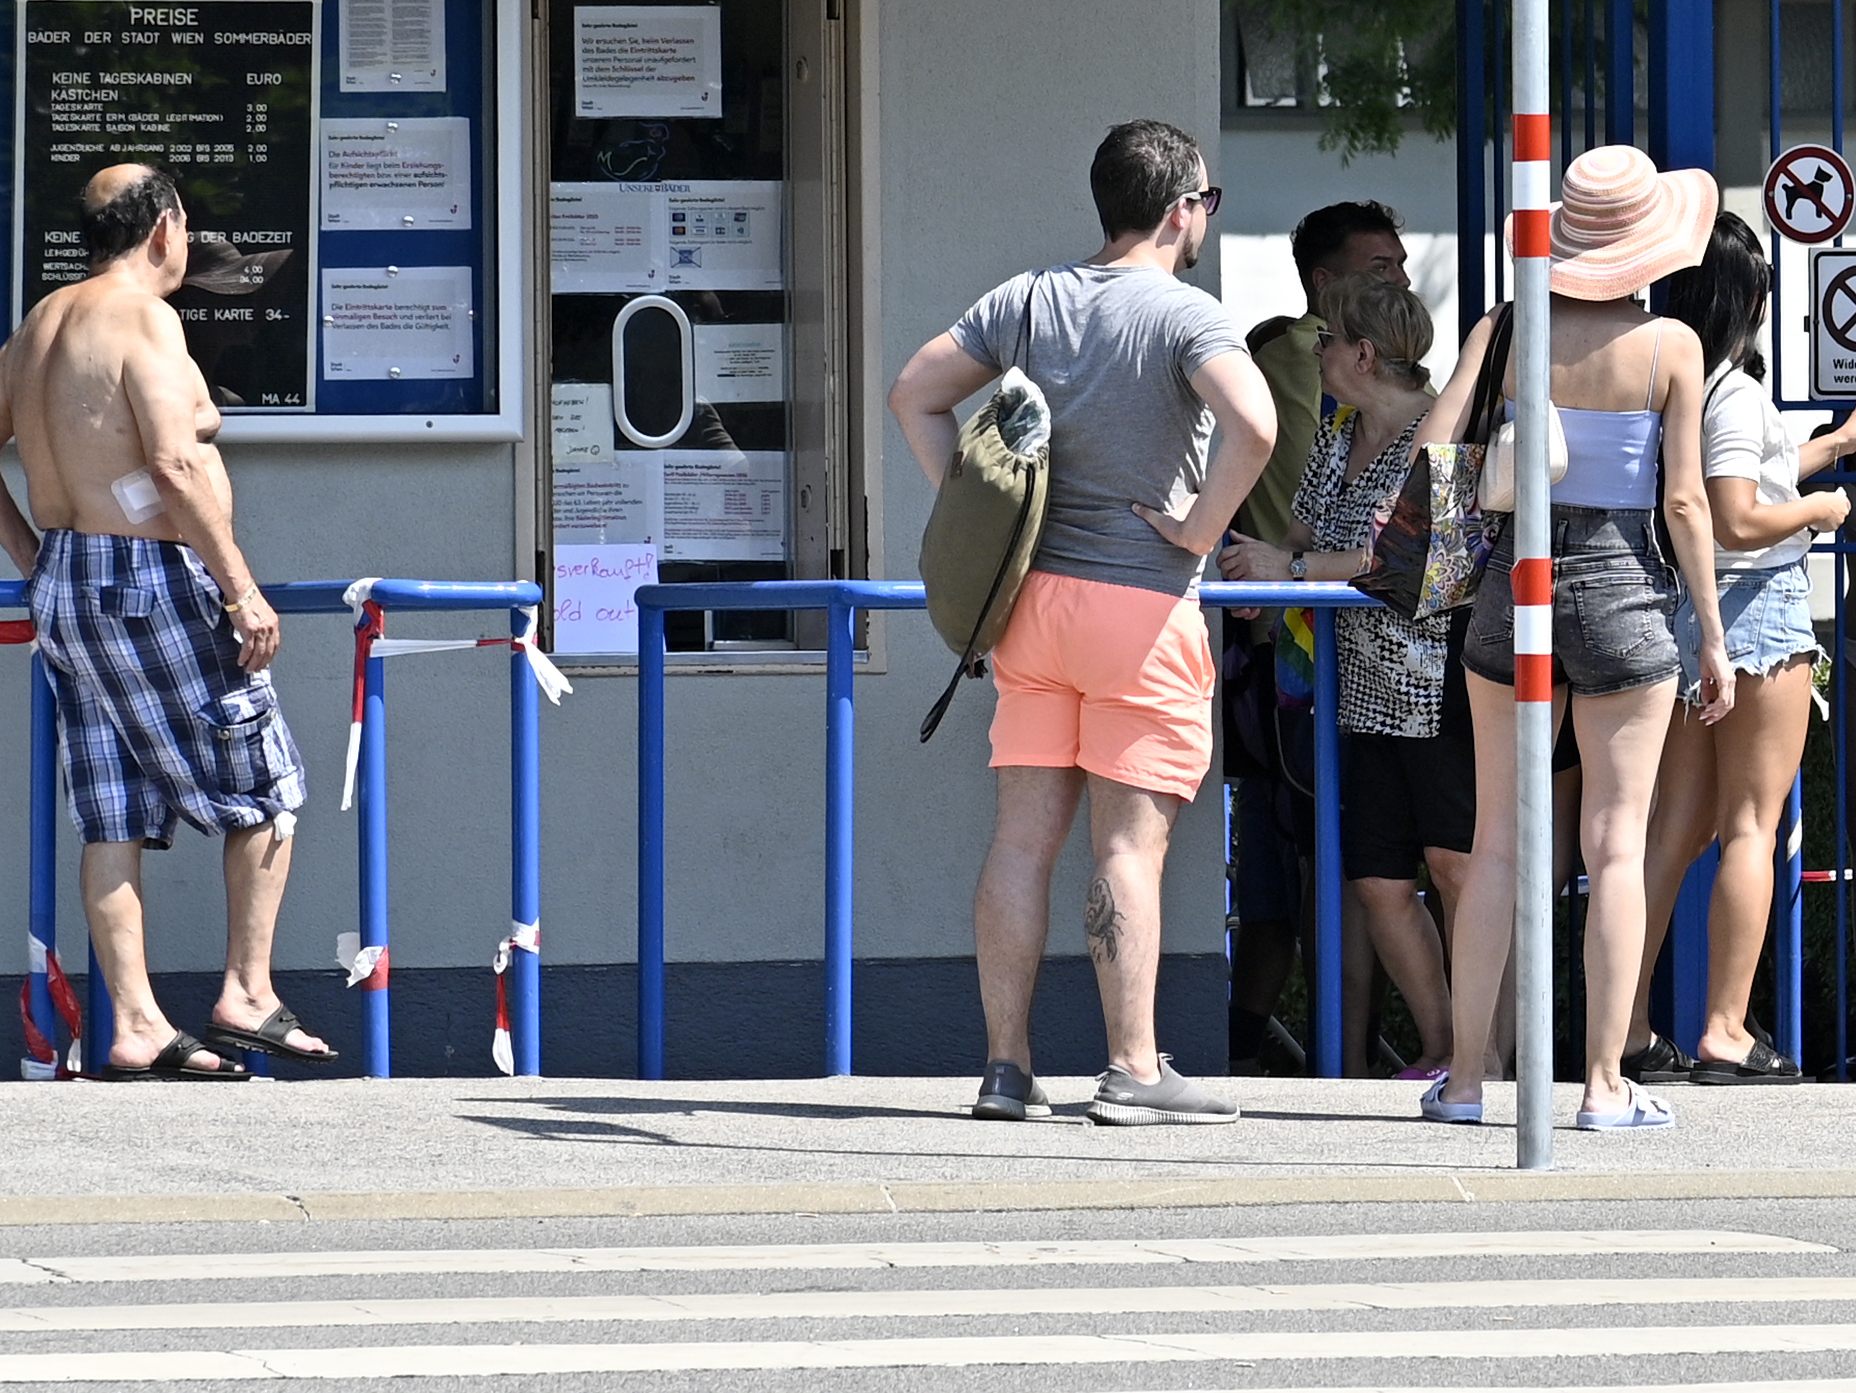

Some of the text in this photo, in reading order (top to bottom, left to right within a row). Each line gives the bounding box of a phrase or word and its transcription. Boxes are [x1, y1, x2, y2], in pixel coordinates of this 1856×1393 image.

[130, 8, 199, 26] PREISE
[28, 28, 312, 45] BÄDER DER STADT WIEN SOMMERBÄDER
[52, 72, 282, 86] KEINE TAGESKABINEN EURO
[51, 86, 119, 101] KÄSTCHEN
[44, 231, 293, 243] KEINE DER BADEZEIT
[214, 308, 254, 320] KARTE
[261, 393, 300, 405] MA 44
